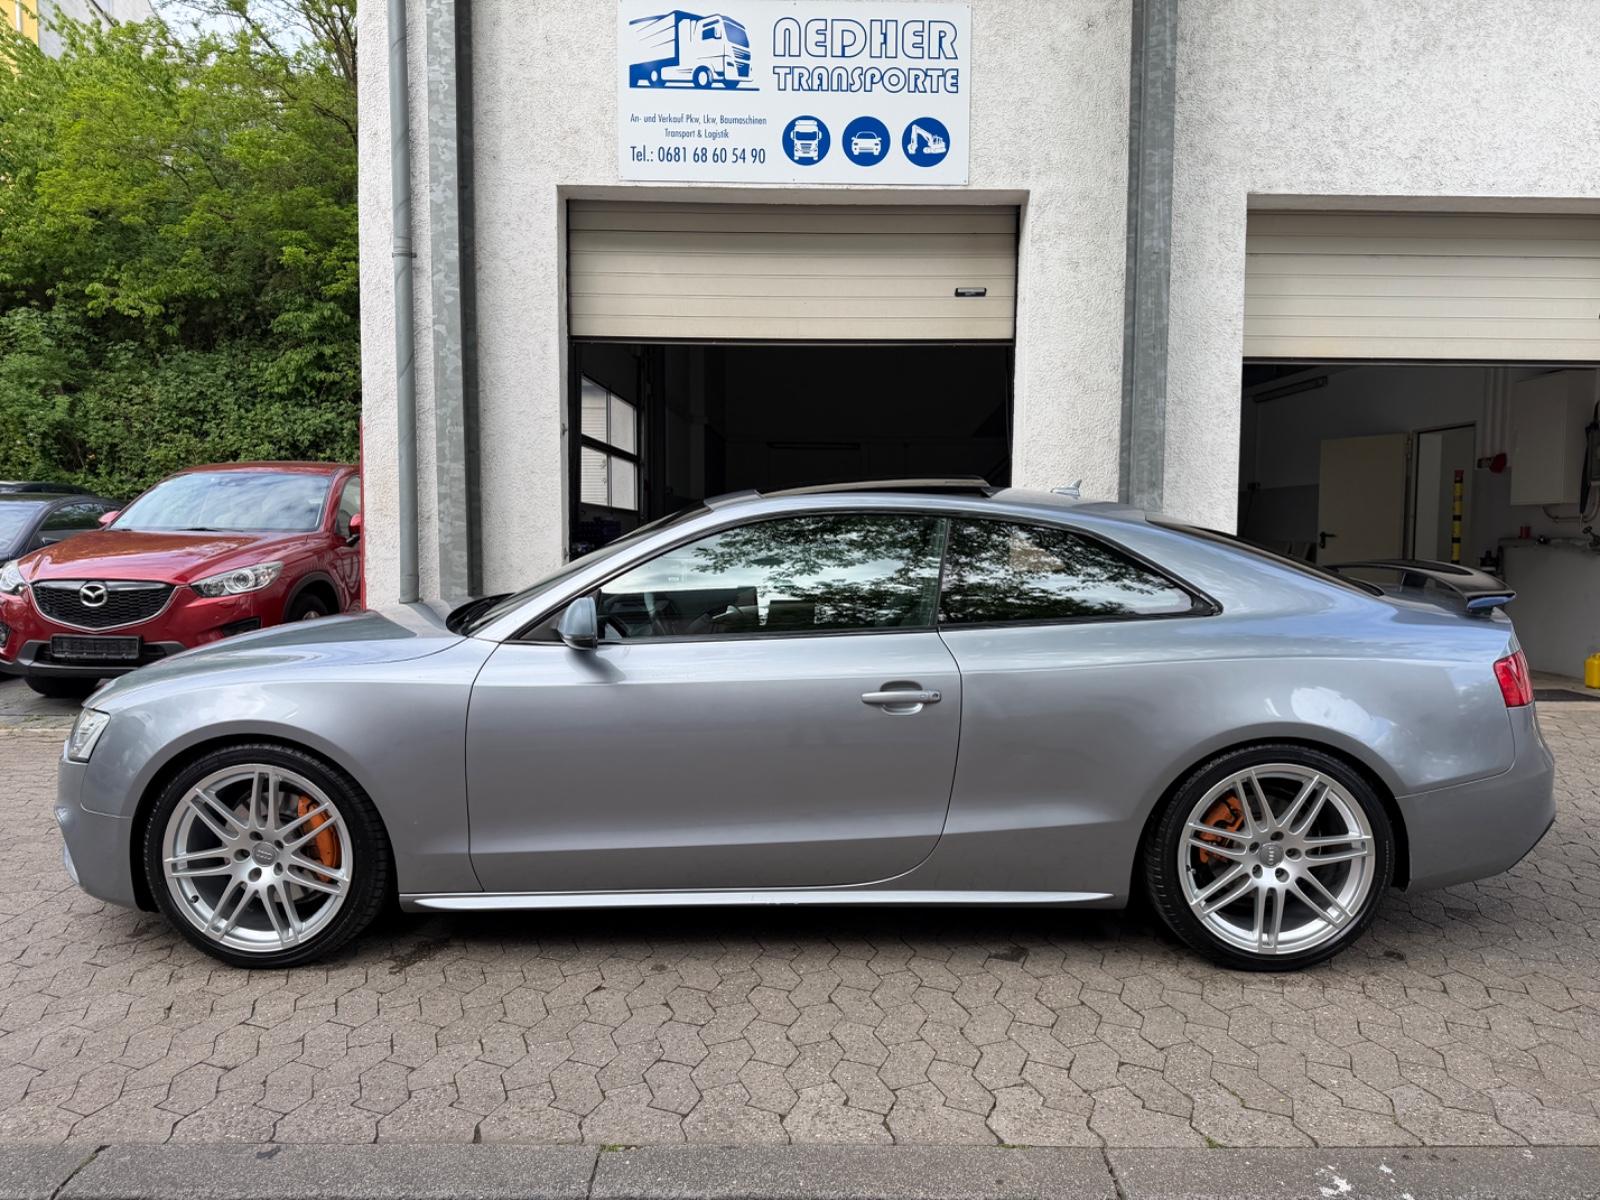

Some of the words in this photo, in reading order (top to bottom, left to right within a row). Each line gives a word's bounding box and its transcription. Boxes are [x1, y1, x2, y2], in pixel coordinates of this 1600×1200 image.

[773, 16, 959, 60] NEDHER
[773, 65, 959, 95] TRANSPORTE
[630, 113, 642, 123] An-
[643, 113, 656, 123] und
[658, 113, 684, 124] Verkauf
[685, 113, 701, 125] Pkw,
[703, 114, 718, 126] Lkw,
[719, 114, 767, 126] Baumaschinen
[664, 128, 695, 140] Transport
[697, 130, 702, 138] &
[704, 128, 729, 141] Logistik
[630, 145, 654, 163] Tel.:
[658, 146, 687, 163] 0681
[692, 146, 708, 164] 68
[712, 147, 728, 164] 60
[731, 148, 747, 164] 54
[750, 148, 766, 165] 90
